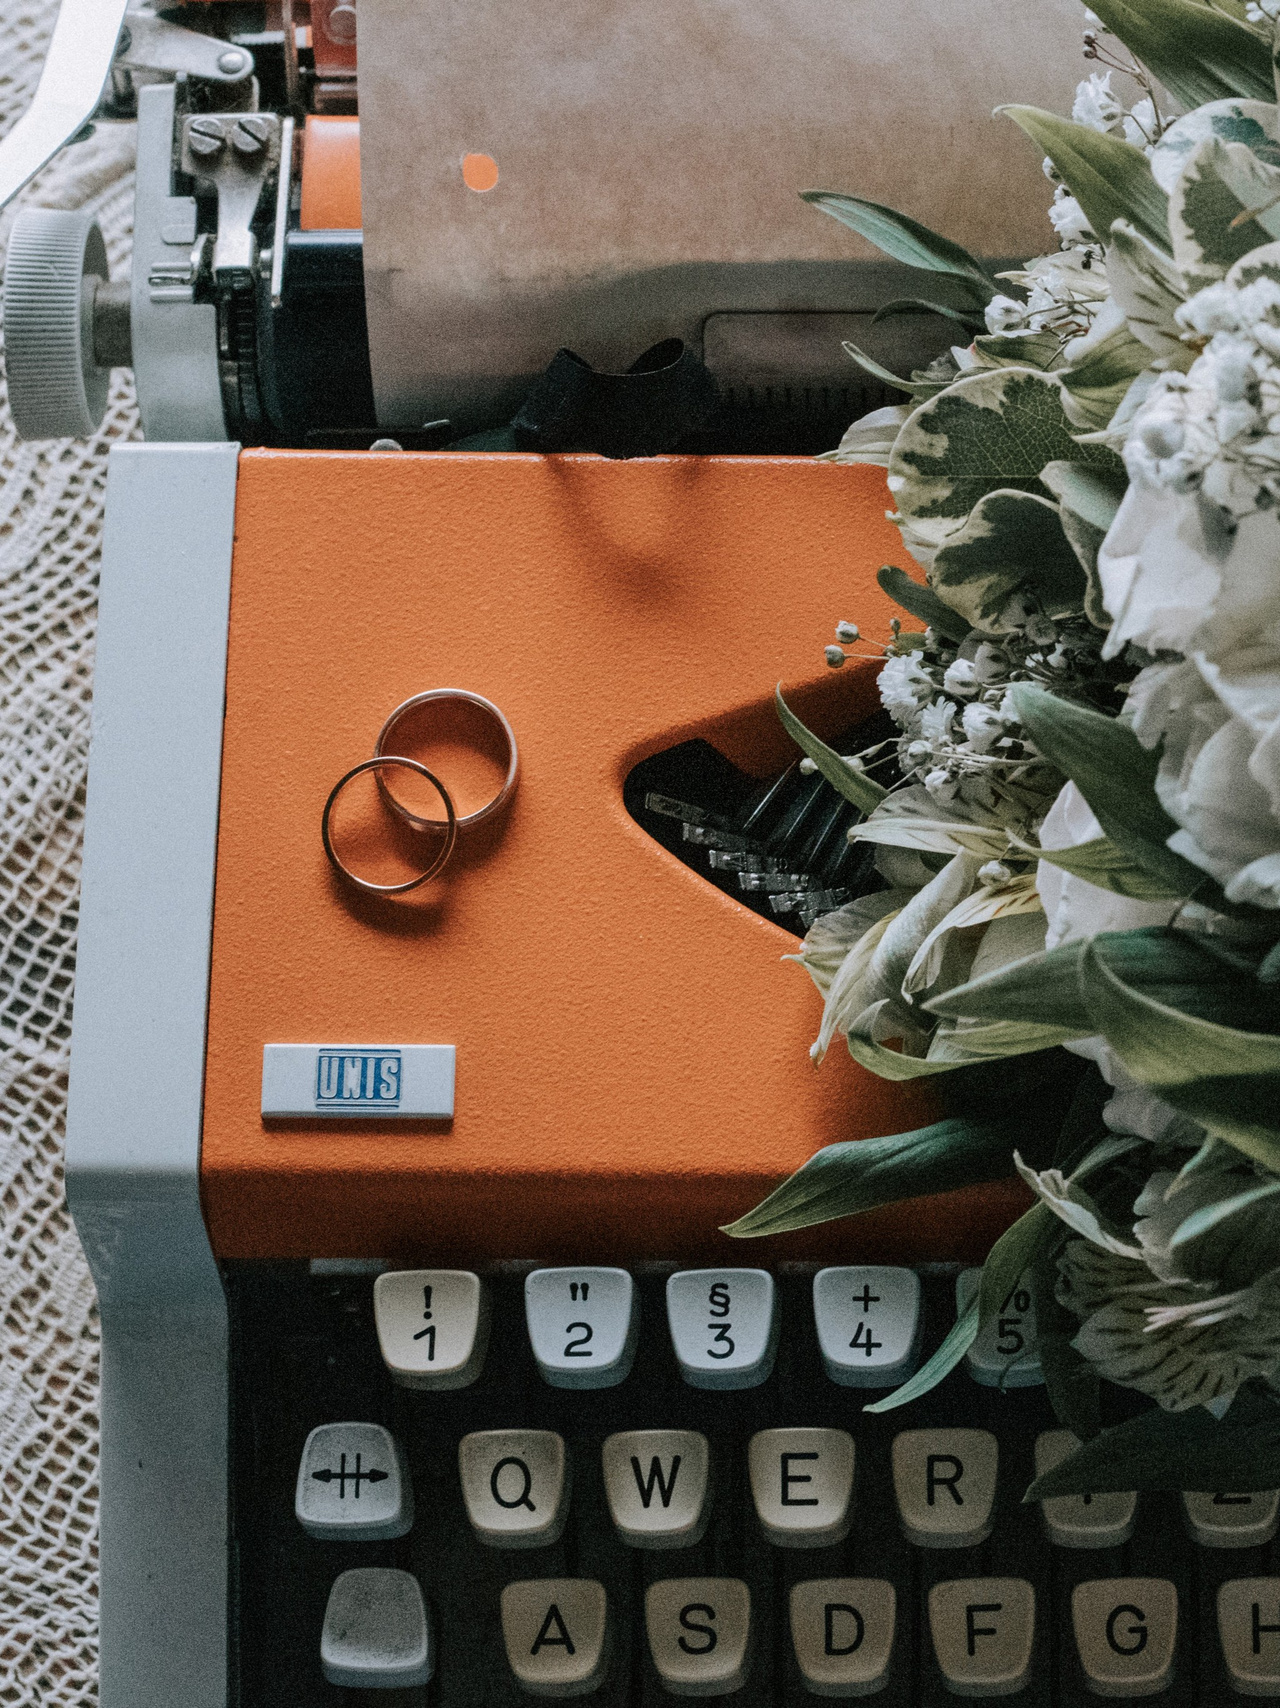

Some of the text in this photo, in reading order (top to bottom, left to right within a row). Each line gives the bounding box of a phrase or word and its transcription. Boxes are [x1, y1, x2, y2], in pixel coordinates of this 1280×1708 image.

[319, 1056, 400, 1100] UNIS
[422, 1284, 434, 1320] !
[708, 1281, 731, 1318] §
[412, 1324, 437, 1362] 1
[563, 1321, 594, 1357] 2
[707, 1322, 735, 1360] 3
[848, 1321, 883, 1357] 4
[996, 1318, 1024, 1355] 5
[490, 1456, 536, 1512] Q
[629, 1454, 683, 1509] W
[780, 1451, 820, 1506] E
[926, 1453, 964, 1507] R
[530, 1603, 576, 1656] A
[677, 1602, 718, 1655] S
[824, 1603, 865, 1657] D
[965, 1602, 1003, 1657] F
[1105, 1603, 1149, 1657] G
